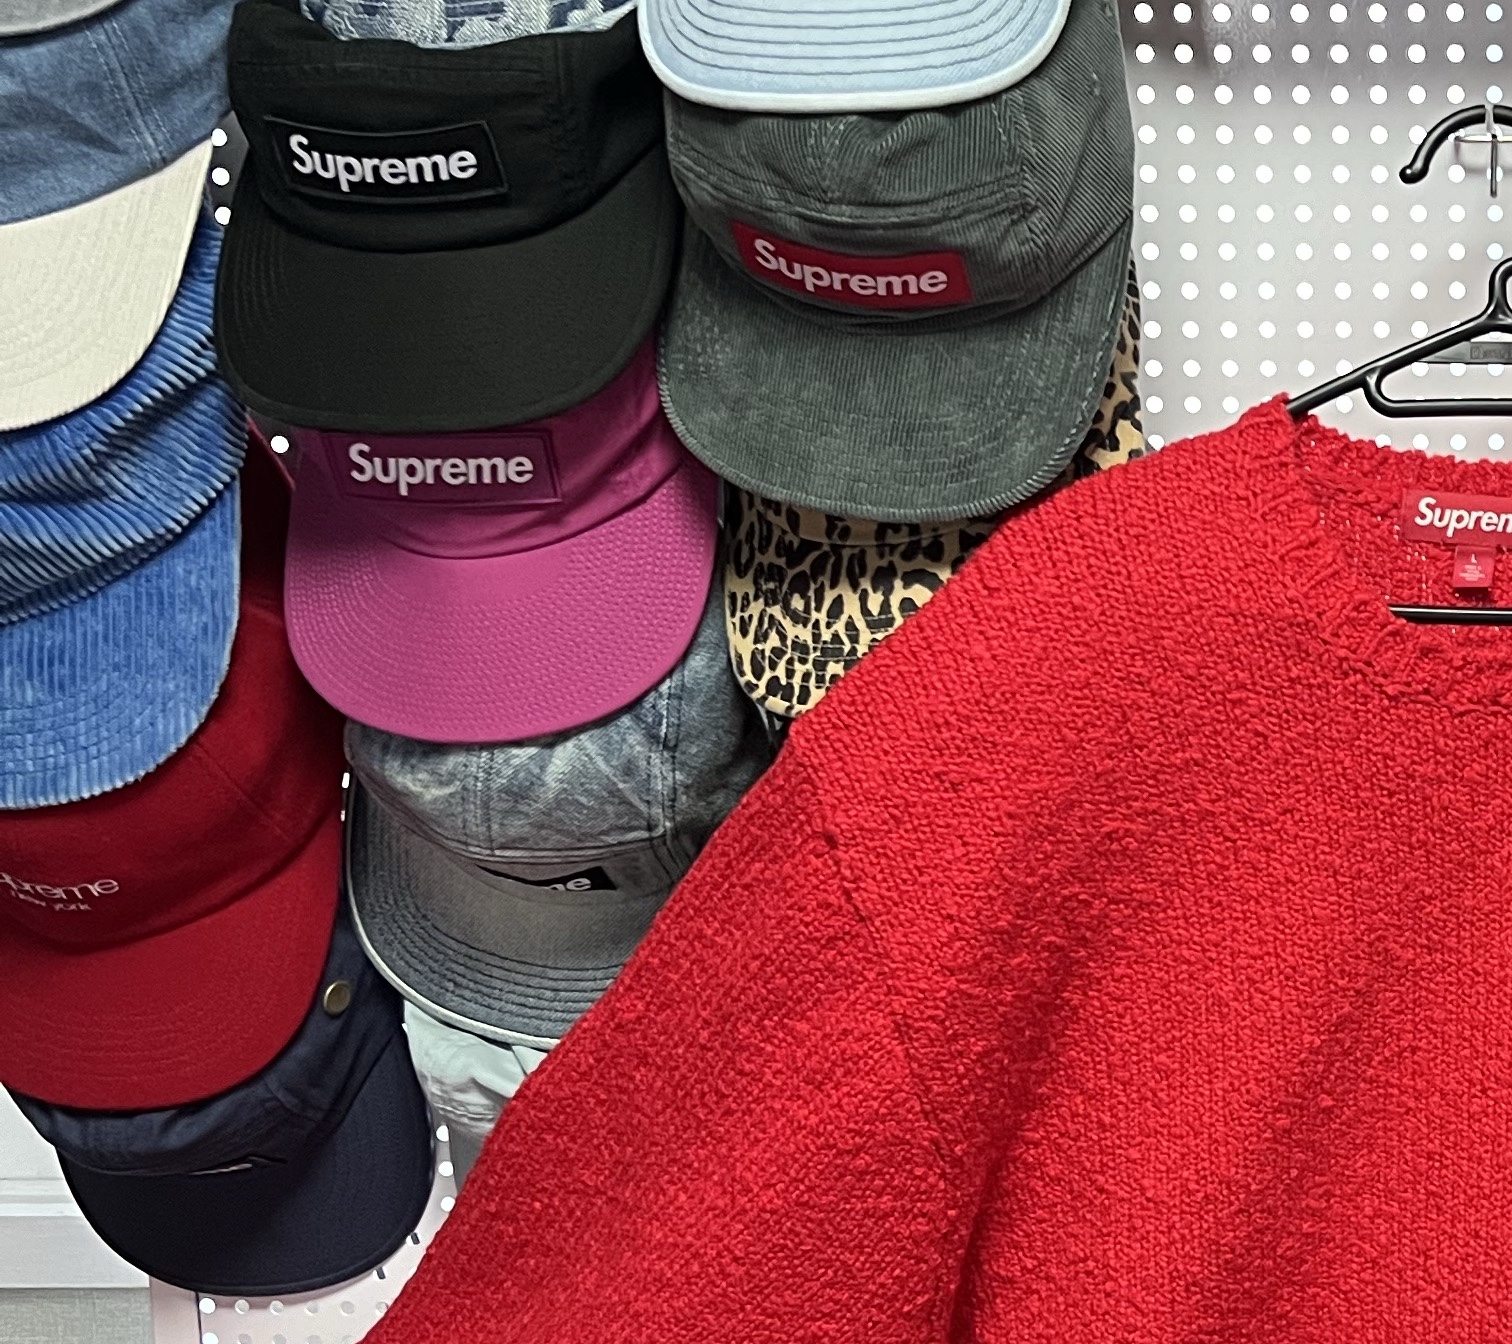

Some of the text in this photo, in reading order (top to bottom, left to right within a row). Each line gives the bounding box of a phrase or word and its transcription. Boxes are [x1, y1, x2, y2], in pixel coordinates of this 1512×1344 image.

[290, 134, 478, 192] Supreme
[754, 239, 948, 296] Supreme
[350, 443, 533, 495] Supreme
